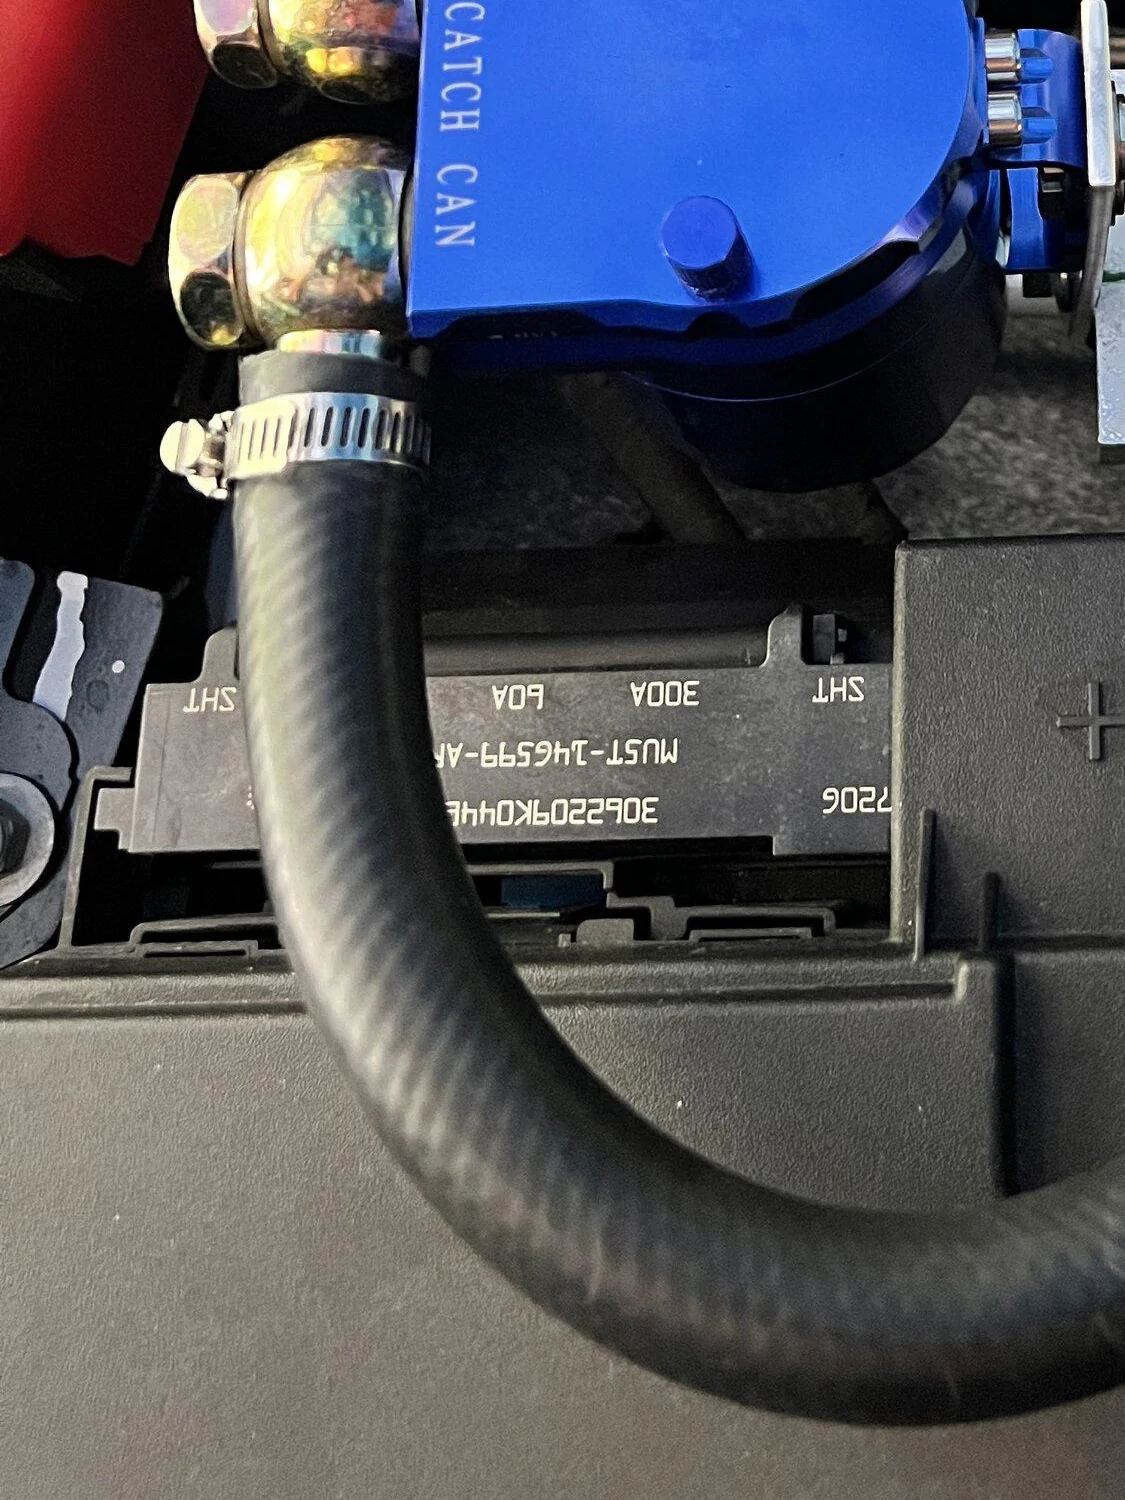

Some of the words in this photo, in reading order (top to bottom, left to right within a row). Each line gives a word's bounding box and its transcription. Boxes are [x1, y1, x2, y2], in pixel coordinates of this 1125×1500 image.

[440, 1, 486, 132] CATCH
[435, 163, 479, 247] CAN
[183, 686, 237, 713] SHT
[493, 683, 545, 711] 60A
[629, 679, 701, 709] 300A
[812, 676, 865, 703] SHT
